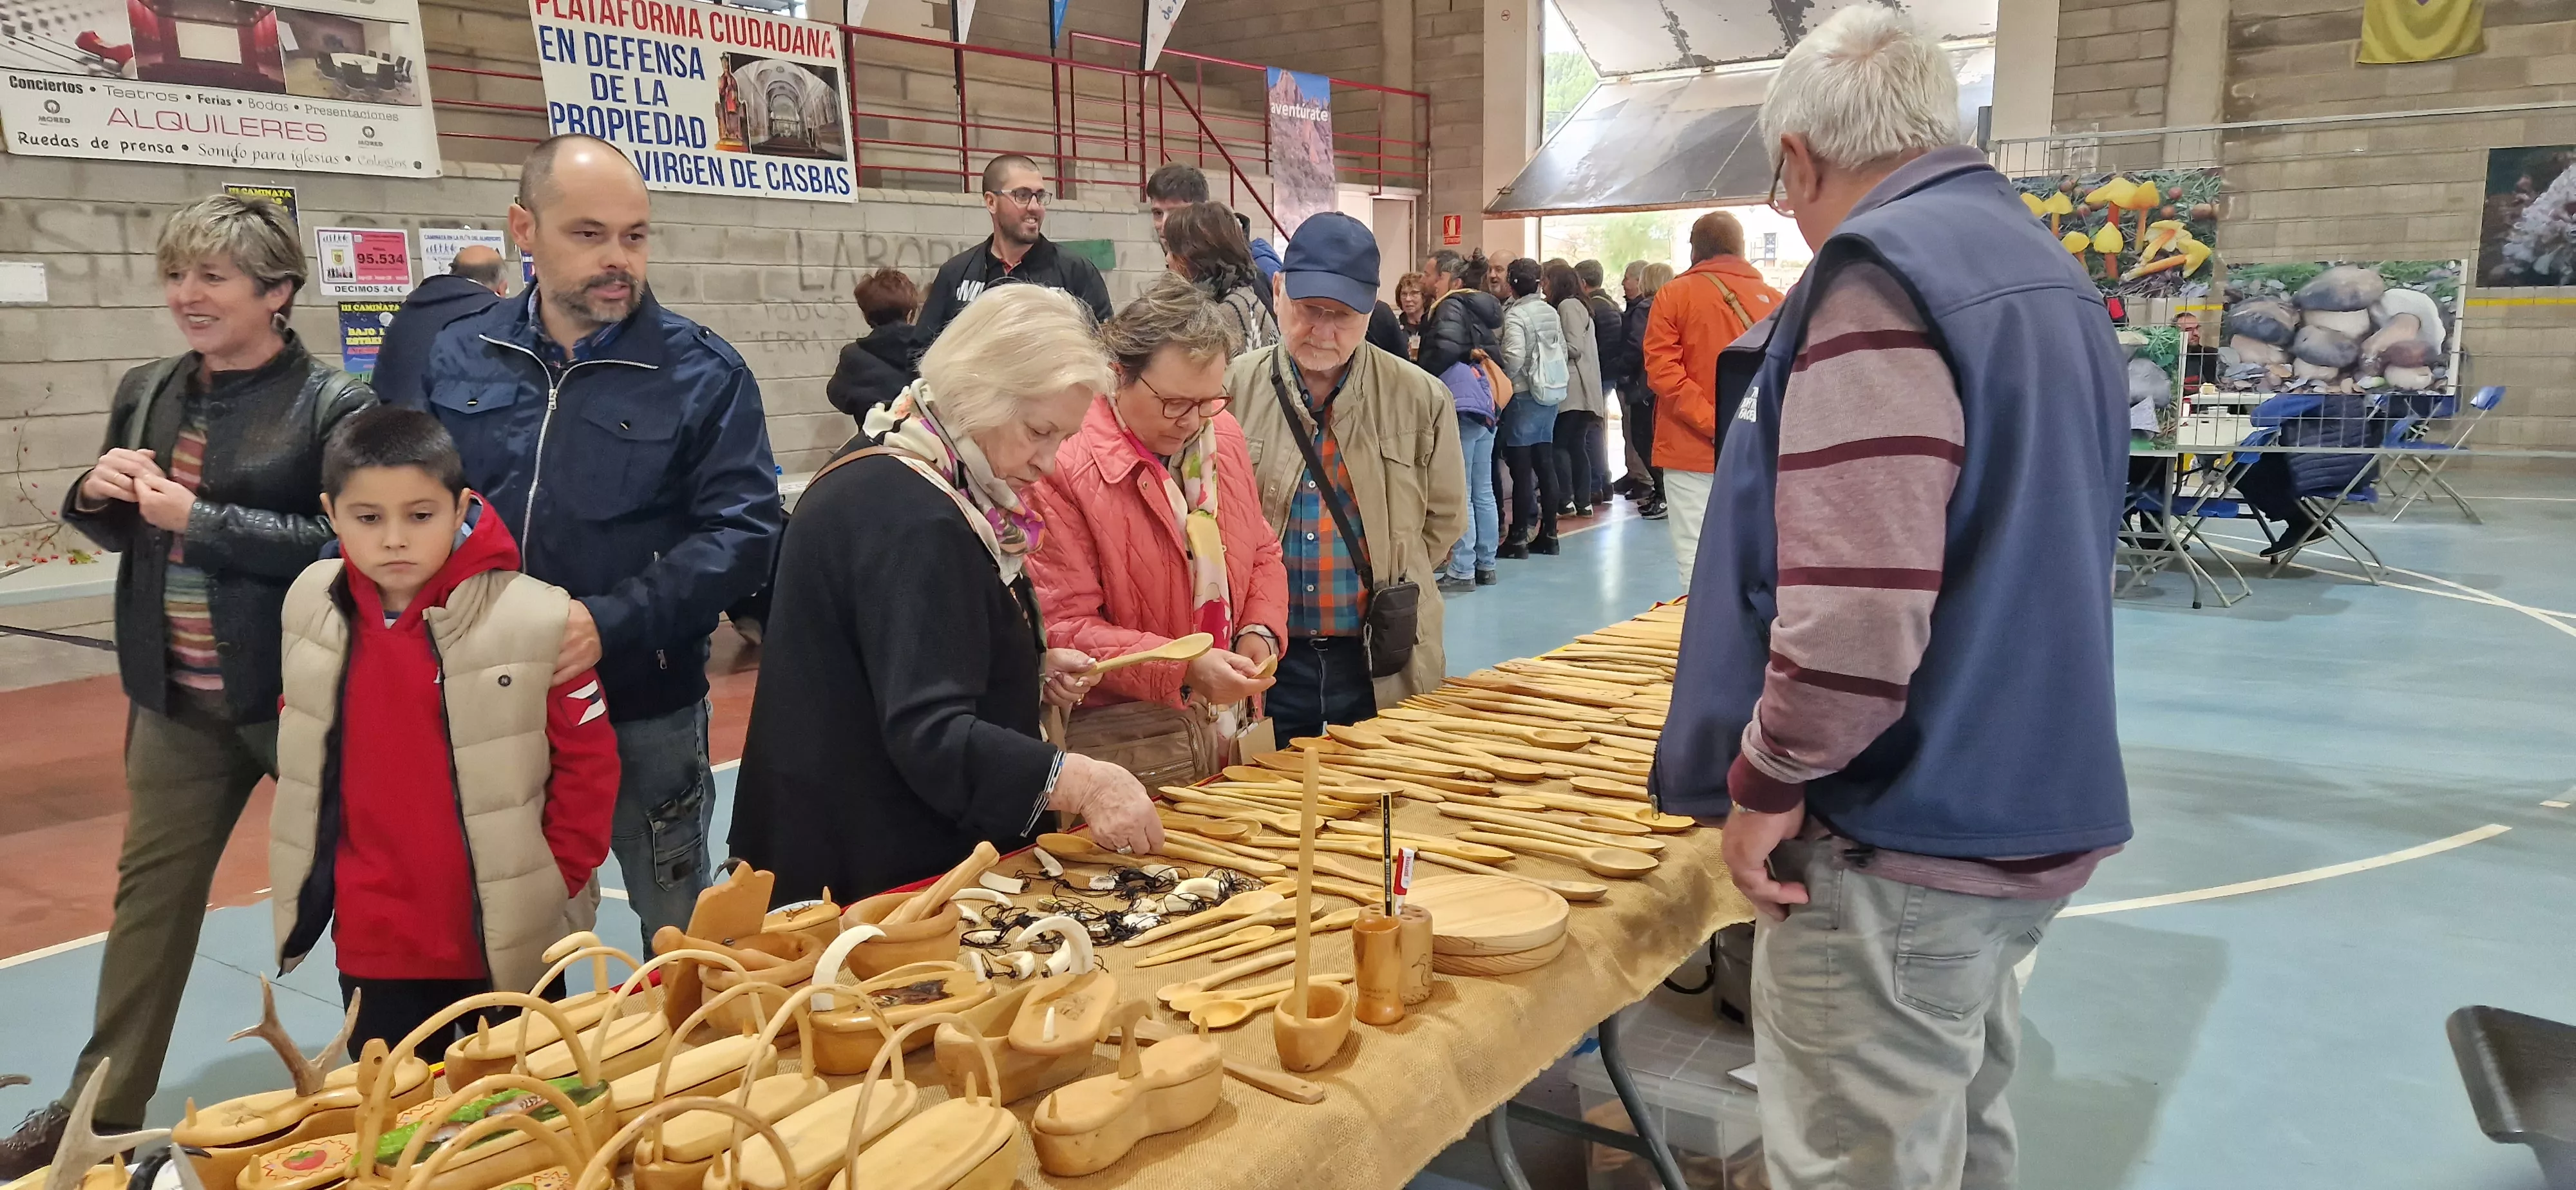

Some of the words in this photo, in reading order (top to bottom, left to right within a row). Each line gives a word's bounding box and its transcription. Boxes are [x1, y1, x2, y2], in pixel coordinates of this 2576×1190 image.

[535, 0, 703, 39] PLATAFORMA
[710, 11, 836, 59] CIUDADANA
[538, 24, 577, 64] EN
[584, 31, 706, 80] DEFENSA
[9, 75, 84, 94] Conciertos
[102, 84, 179, 102] Teatros
[197, 93, 231, 107] Ferias
[247, 97, 289, 112] Bodas
[305, 104, 399, 122] Presentaciones
[590, 72, 627, 103] DE
[634, 77, 669, 108] LA
[106, 107, 328, 143] ALQUILERES
[549, 101, 707, 149] PROPIEDAD
[1270, 100, 1329, 122] aventúrate
[17, 131, 79, 148] Ruedas
[90, 136, 109, 149] de
[120, 140, 175, 154] prensa
[198, 143, 247, 159] Sonido
[252, 149, 285, 165] para
[290, 148, 339, 168] iglesias
[634, 149, 726, 187] VIRGEN
[730, 158, 762, 189] DE
[764, 160, 851, 196] CASBAS
[241, 187, 292, 198] CAMINATA
[356, 253, 404, 265] 95.534
